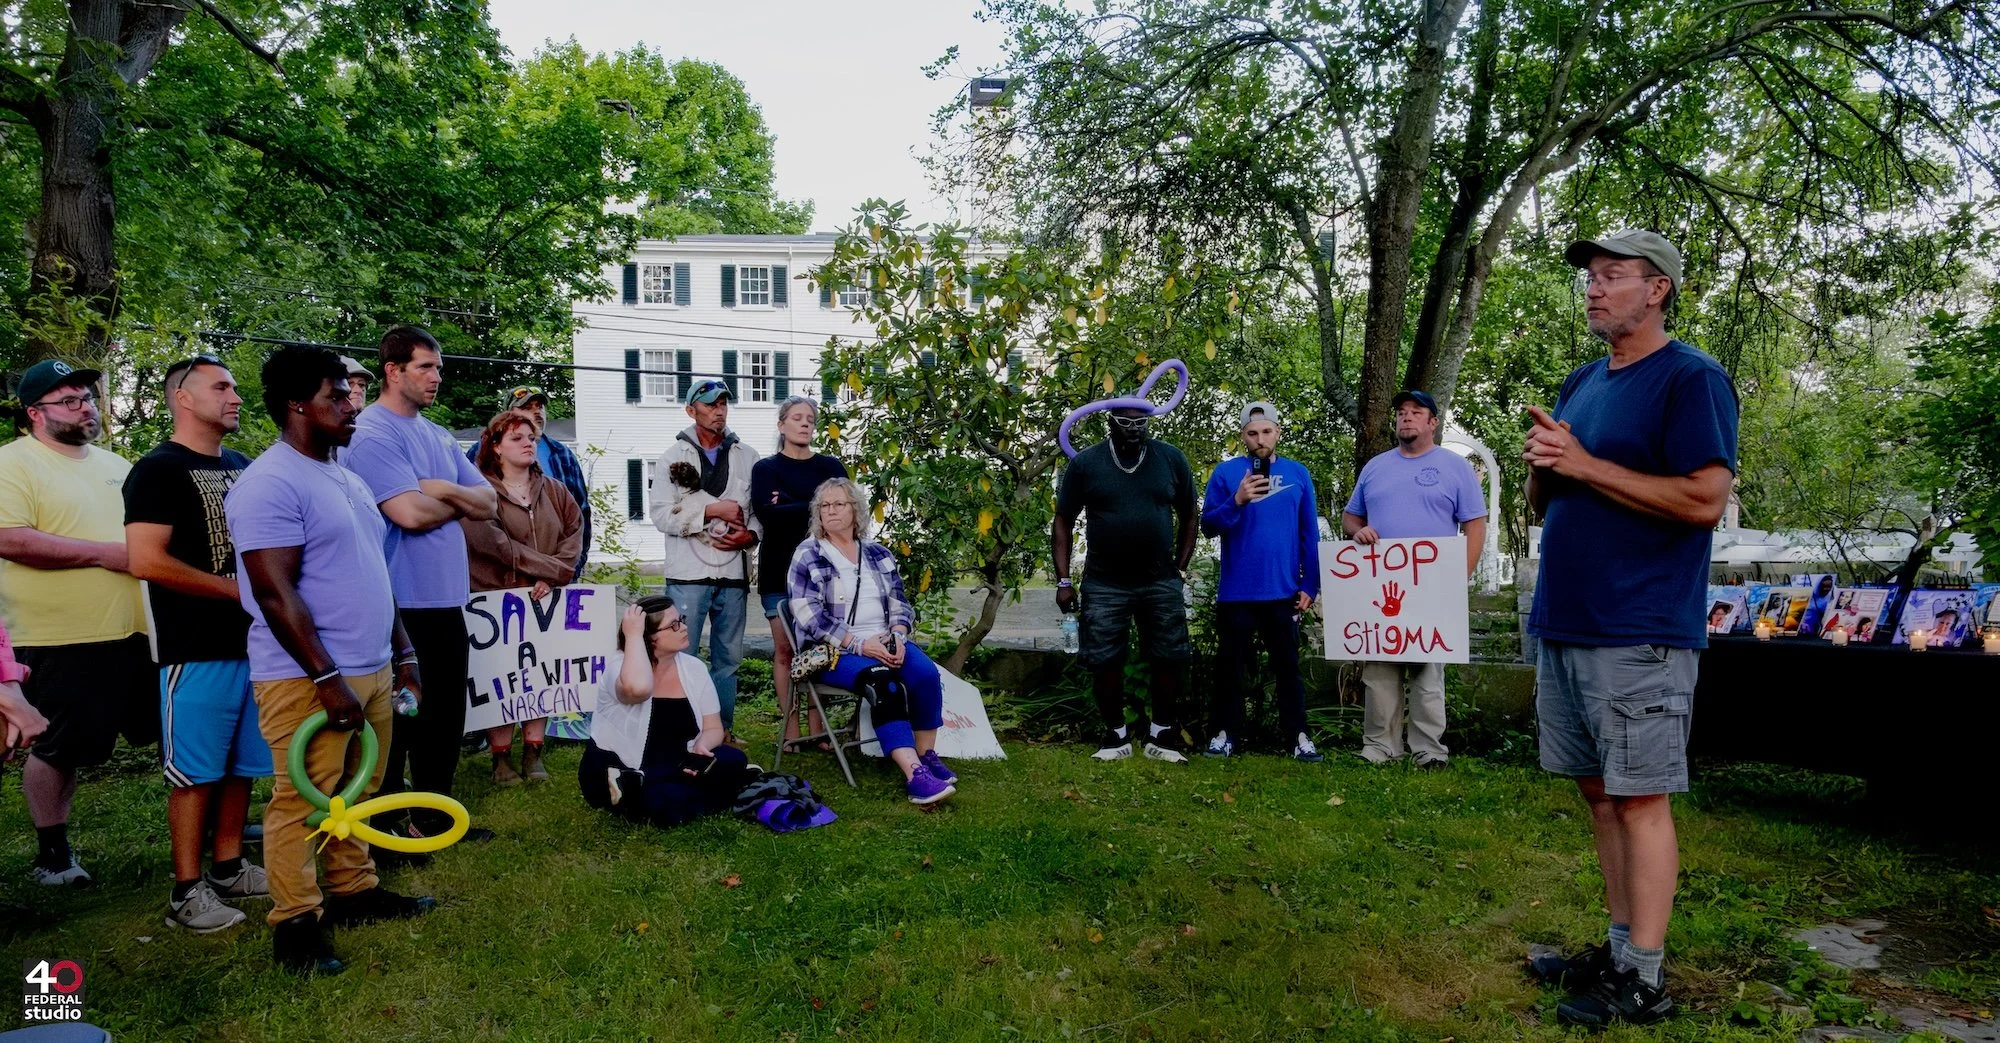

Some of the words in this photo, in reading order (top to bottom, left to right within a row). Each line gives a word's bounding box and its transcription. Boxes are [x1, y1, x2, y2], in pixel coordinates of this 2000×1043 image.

[465, 588, 595, 650] SAVE
[518, 641, 537, 669] A
[467, 669, 533, 708] LIFE
[541, 656, 605, 686] WITH
[501, 684, 581, 723] NARCAN
